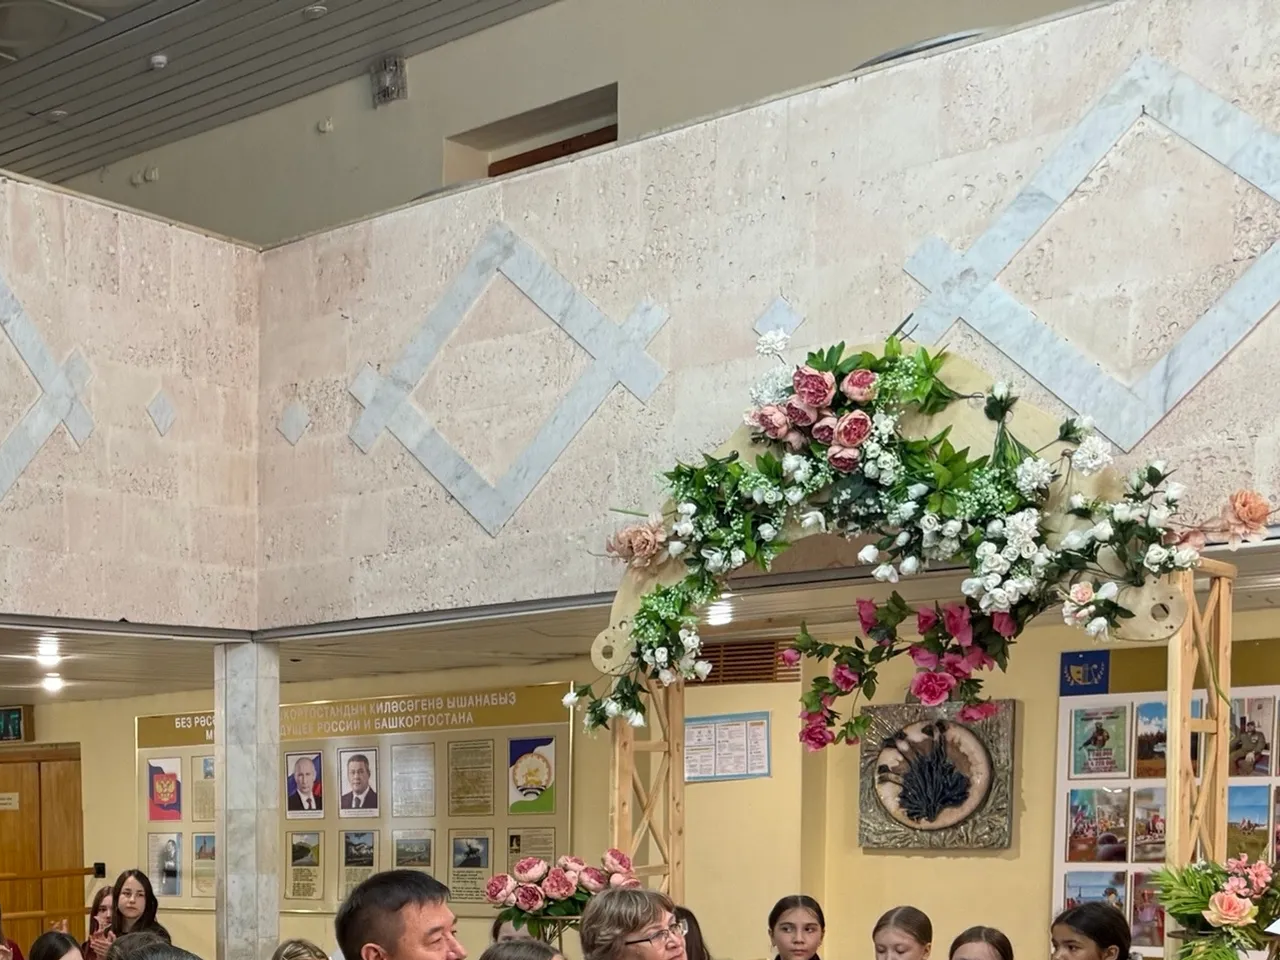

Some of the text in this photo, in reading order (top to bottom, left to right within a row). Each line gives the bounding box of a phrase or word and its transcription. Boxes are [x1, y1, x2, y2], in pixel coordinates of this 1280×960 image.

[318, 719, 360, 734] РОССИИ
[363, 718, 372, 731] И
[374, 711, 474, 730] БАШКОРТОСТАНА
